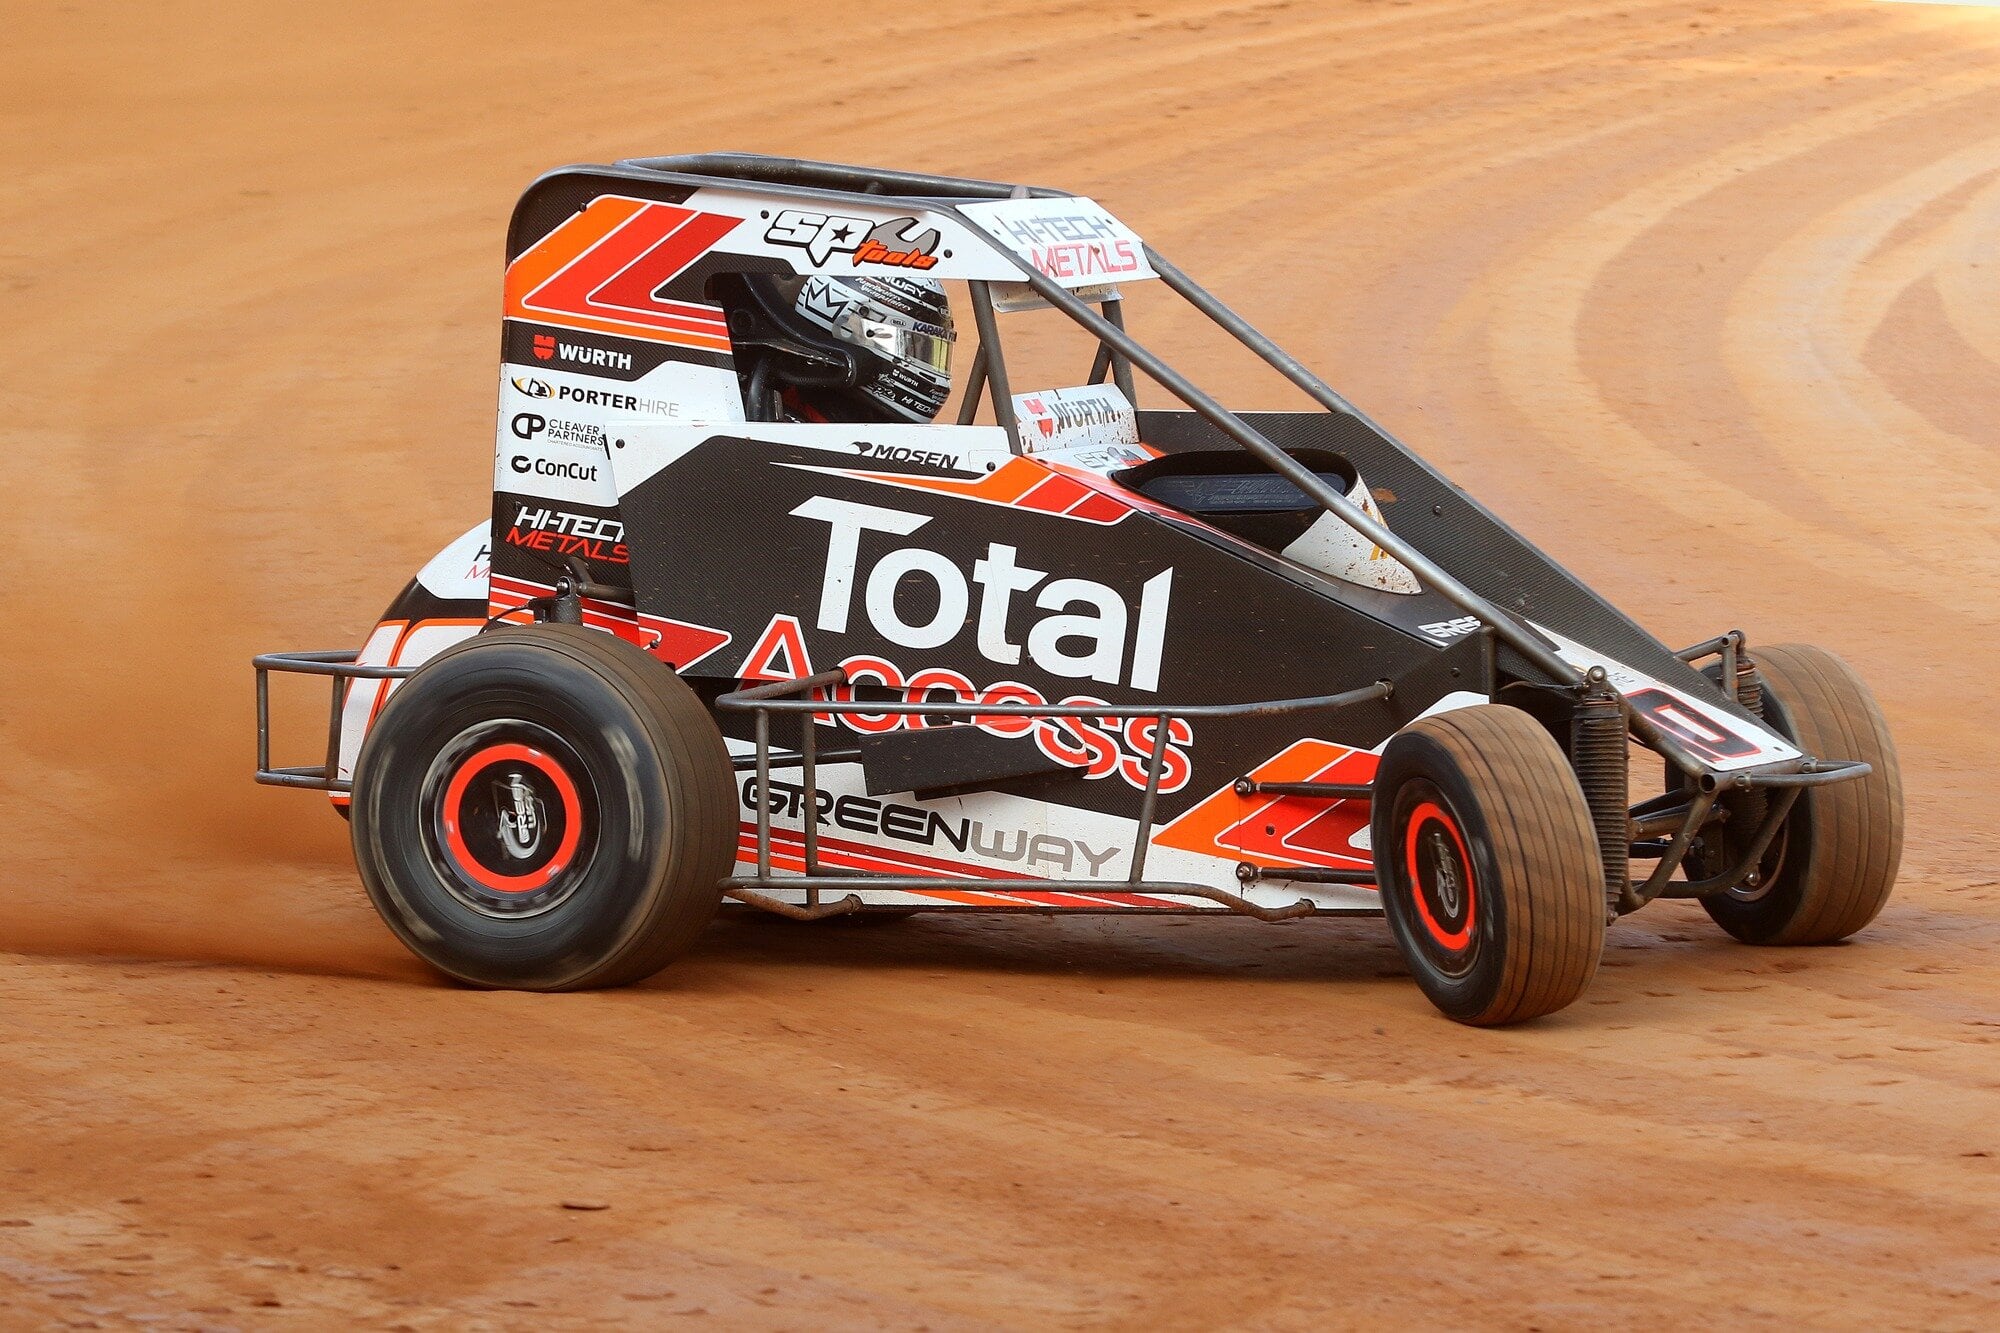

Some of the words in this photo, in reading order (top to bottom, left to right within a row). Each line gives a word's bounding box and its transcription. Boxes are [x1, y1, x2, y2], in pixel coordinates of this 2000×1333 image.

[764, 209, 876, 268] SP
[852, 239, 939, 271] tools
[1030, 240, 1138, 278] METALS
[547, 428, 604, 446] PARTNERS
[549, 418, 600, 436] CLEAVER
[534, 458, 598, 482] ConCut
[871, 444, 959, 469] MOSEN
[505, 526, 630, 565] METALS
[788, 494, 1173, 693] Total
[742, 776, 1122, 878] GREENWAY
